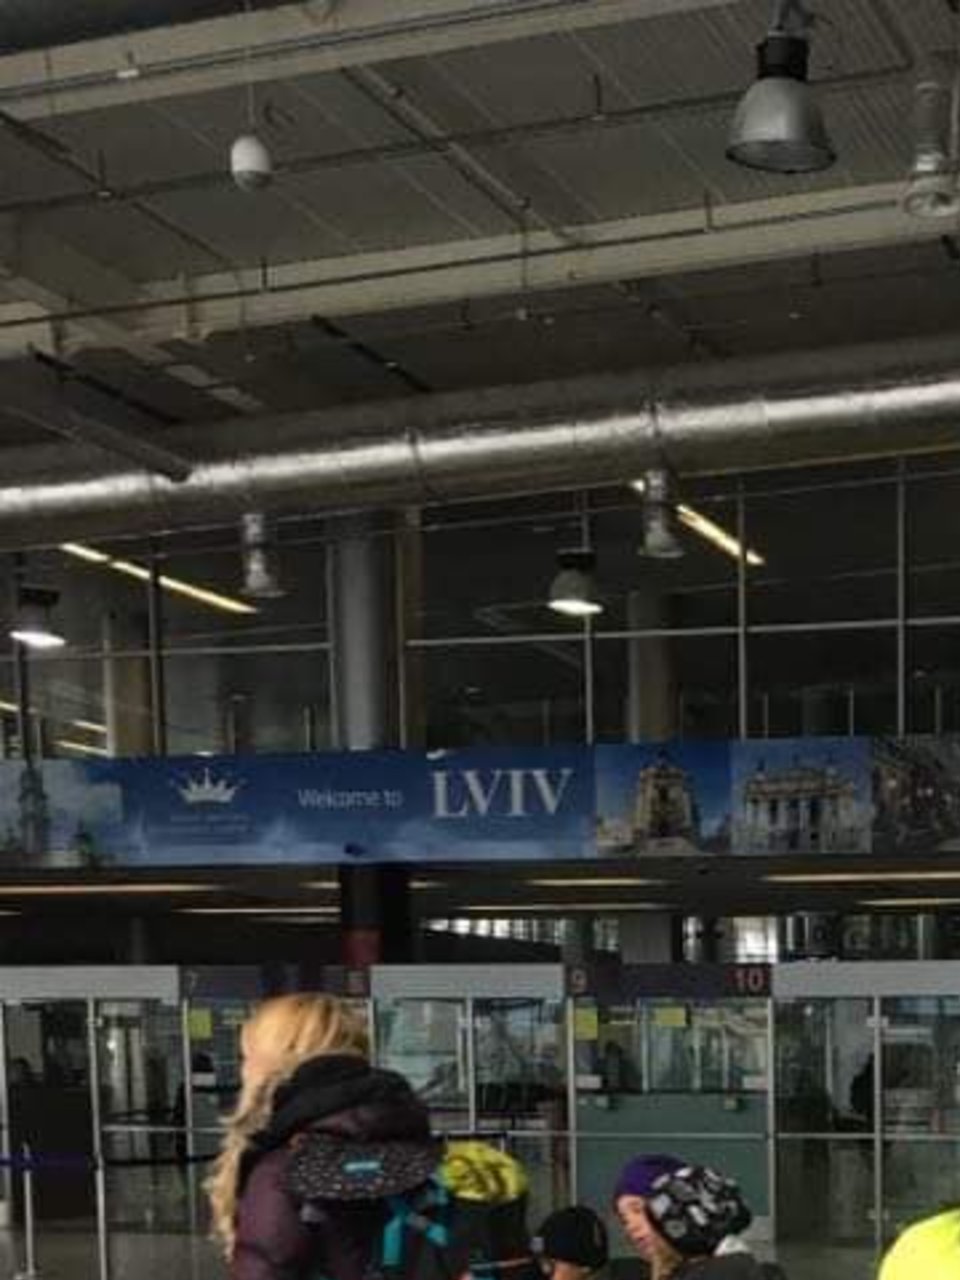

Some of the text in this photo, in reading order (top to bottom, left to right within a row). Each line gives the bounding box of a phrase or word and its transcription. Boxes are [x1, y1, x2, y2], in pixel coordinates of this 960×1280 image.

[297, 767, 574, 818] Welcome to LVIV
[735, 967, 765, 993] 10
